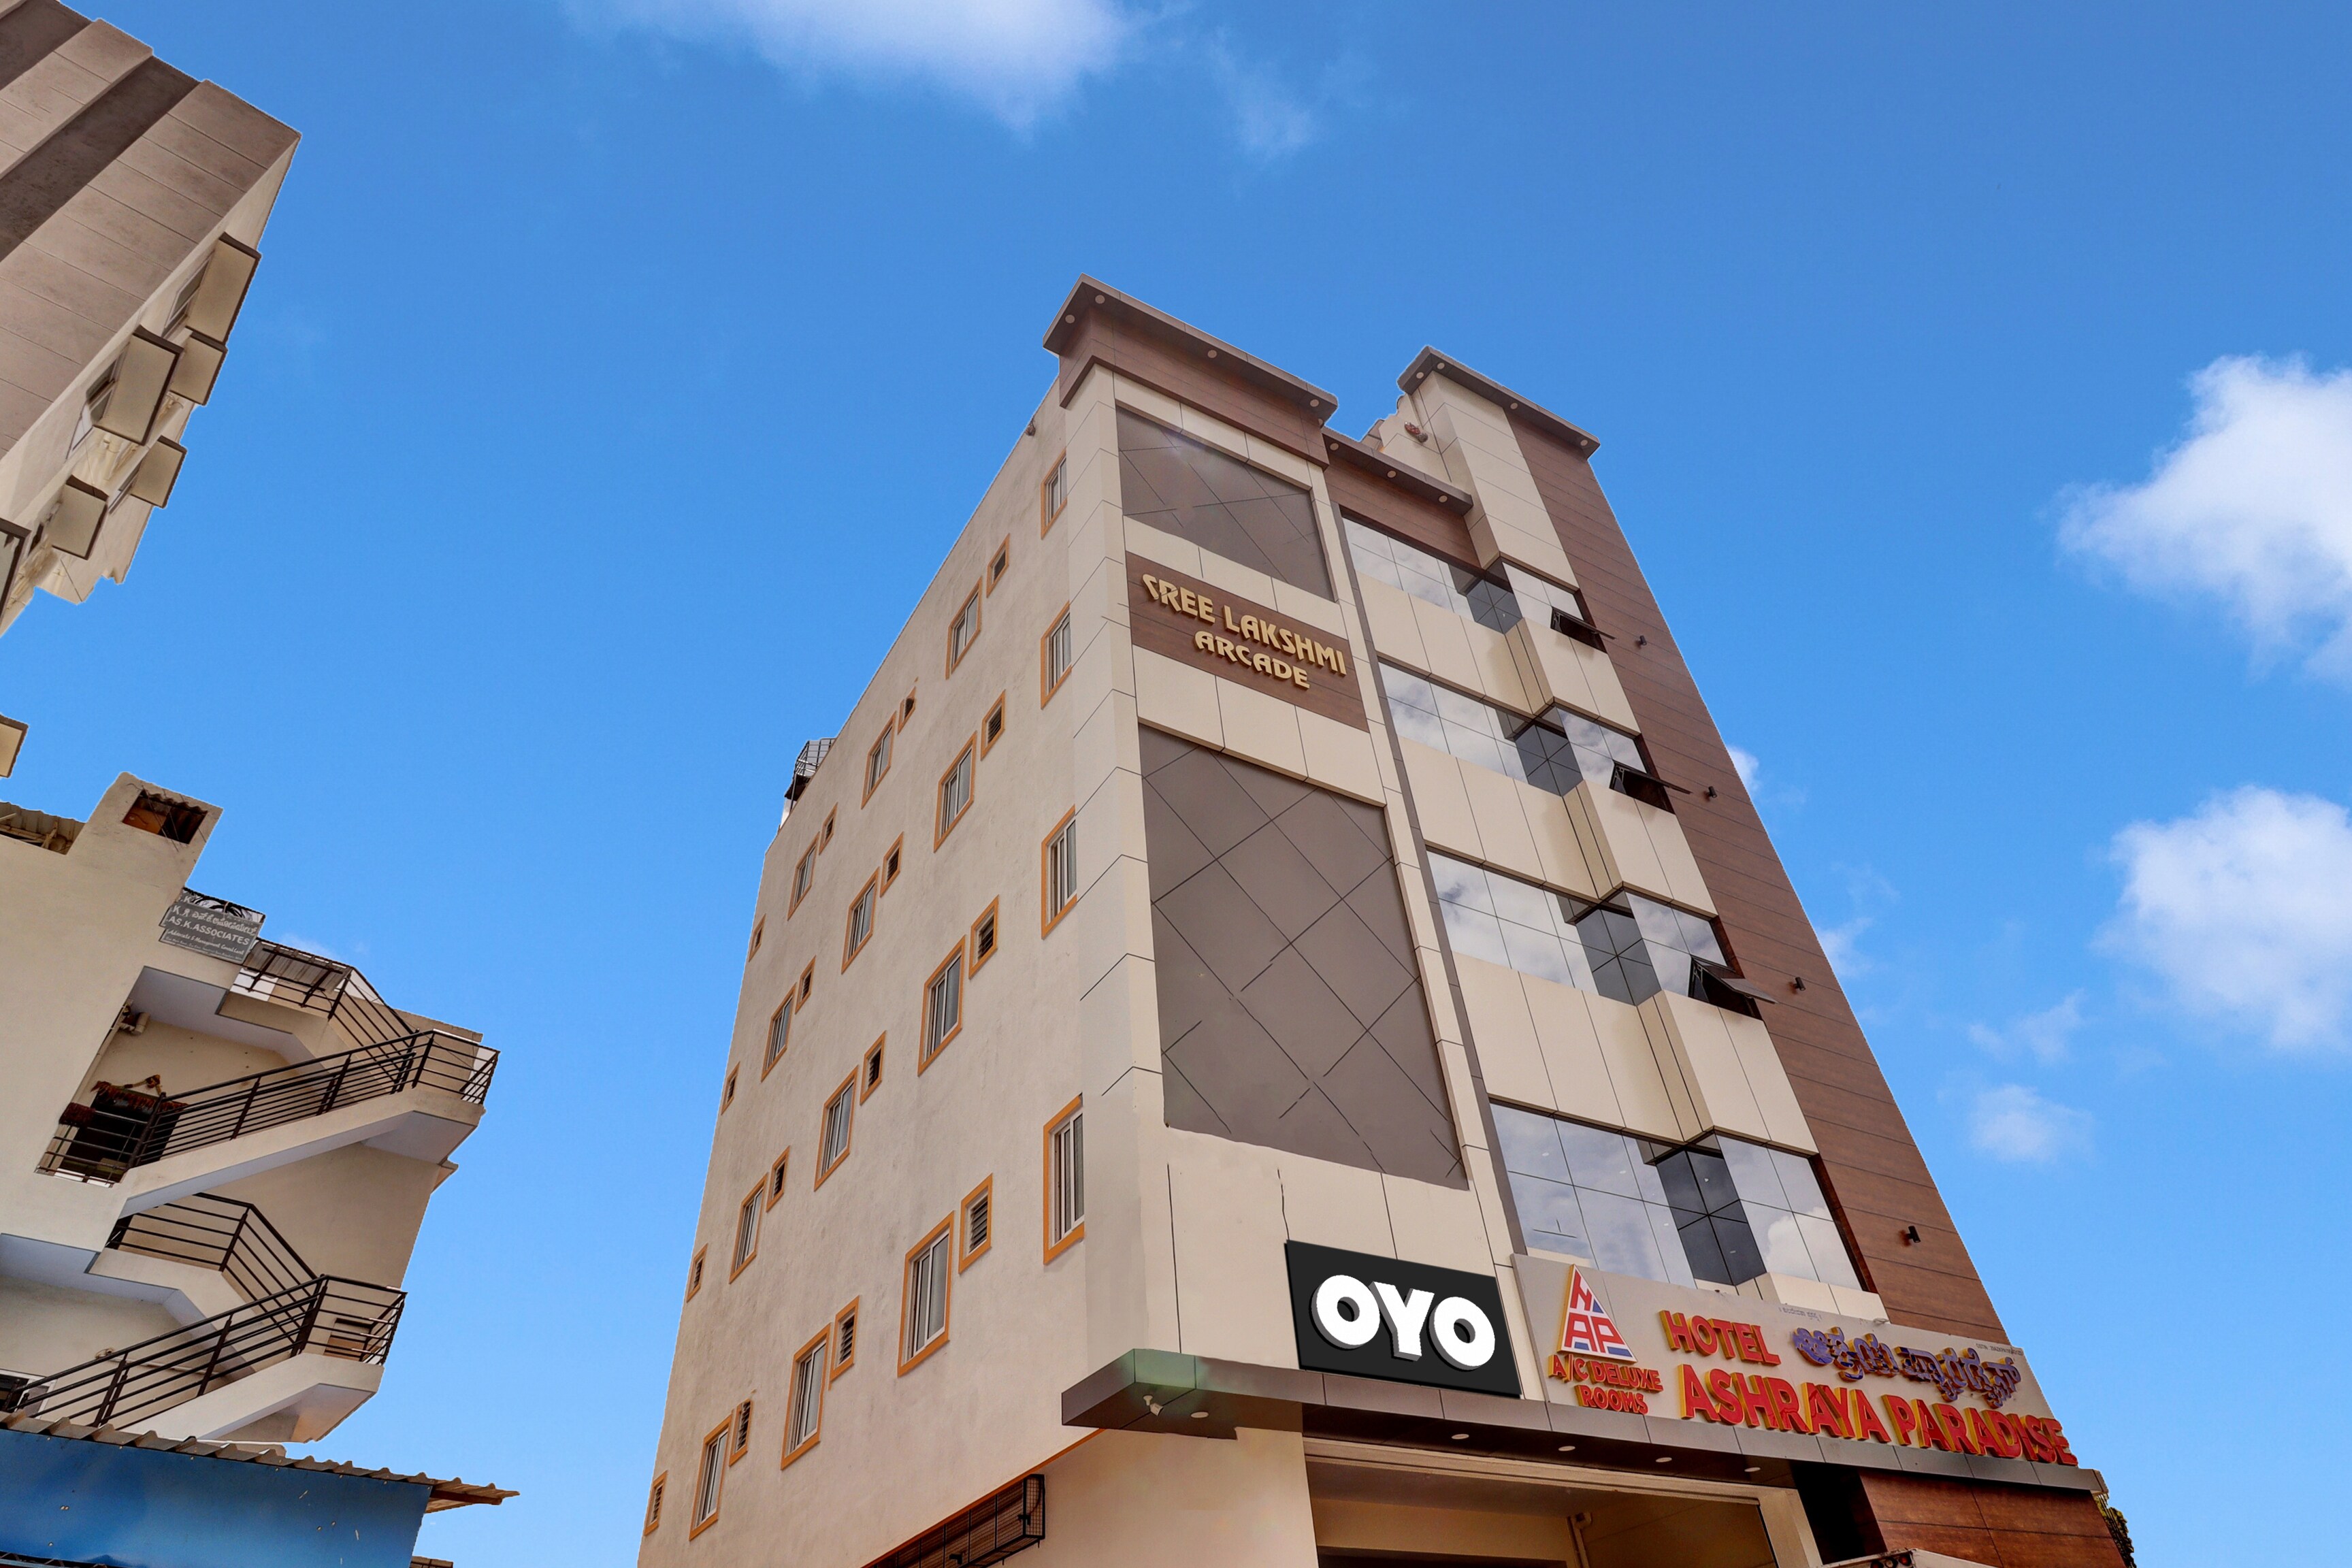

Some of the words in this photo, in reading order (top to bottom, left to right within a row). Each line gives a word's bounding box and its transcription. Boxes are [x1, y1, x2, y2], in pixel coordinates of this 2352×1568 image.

[1194, 630, 1310, 689] ARCADE
[1224, 604, 1347, 676] LAKSHMI
[1310, 1275, 1495, 1370] OYO
[1659, 1309, 1781, 1366] HOTEL
[1548, 1354, 1588, 1383] A/C
[1587, 1360, 1663, 1393] DELUXE
[1574, 1384, 1648, 1415] ROOMS
[1678, 1364, 1891, 1443] ASHRAYA
[1881, 1394, 2078, 1467] PARADISE
